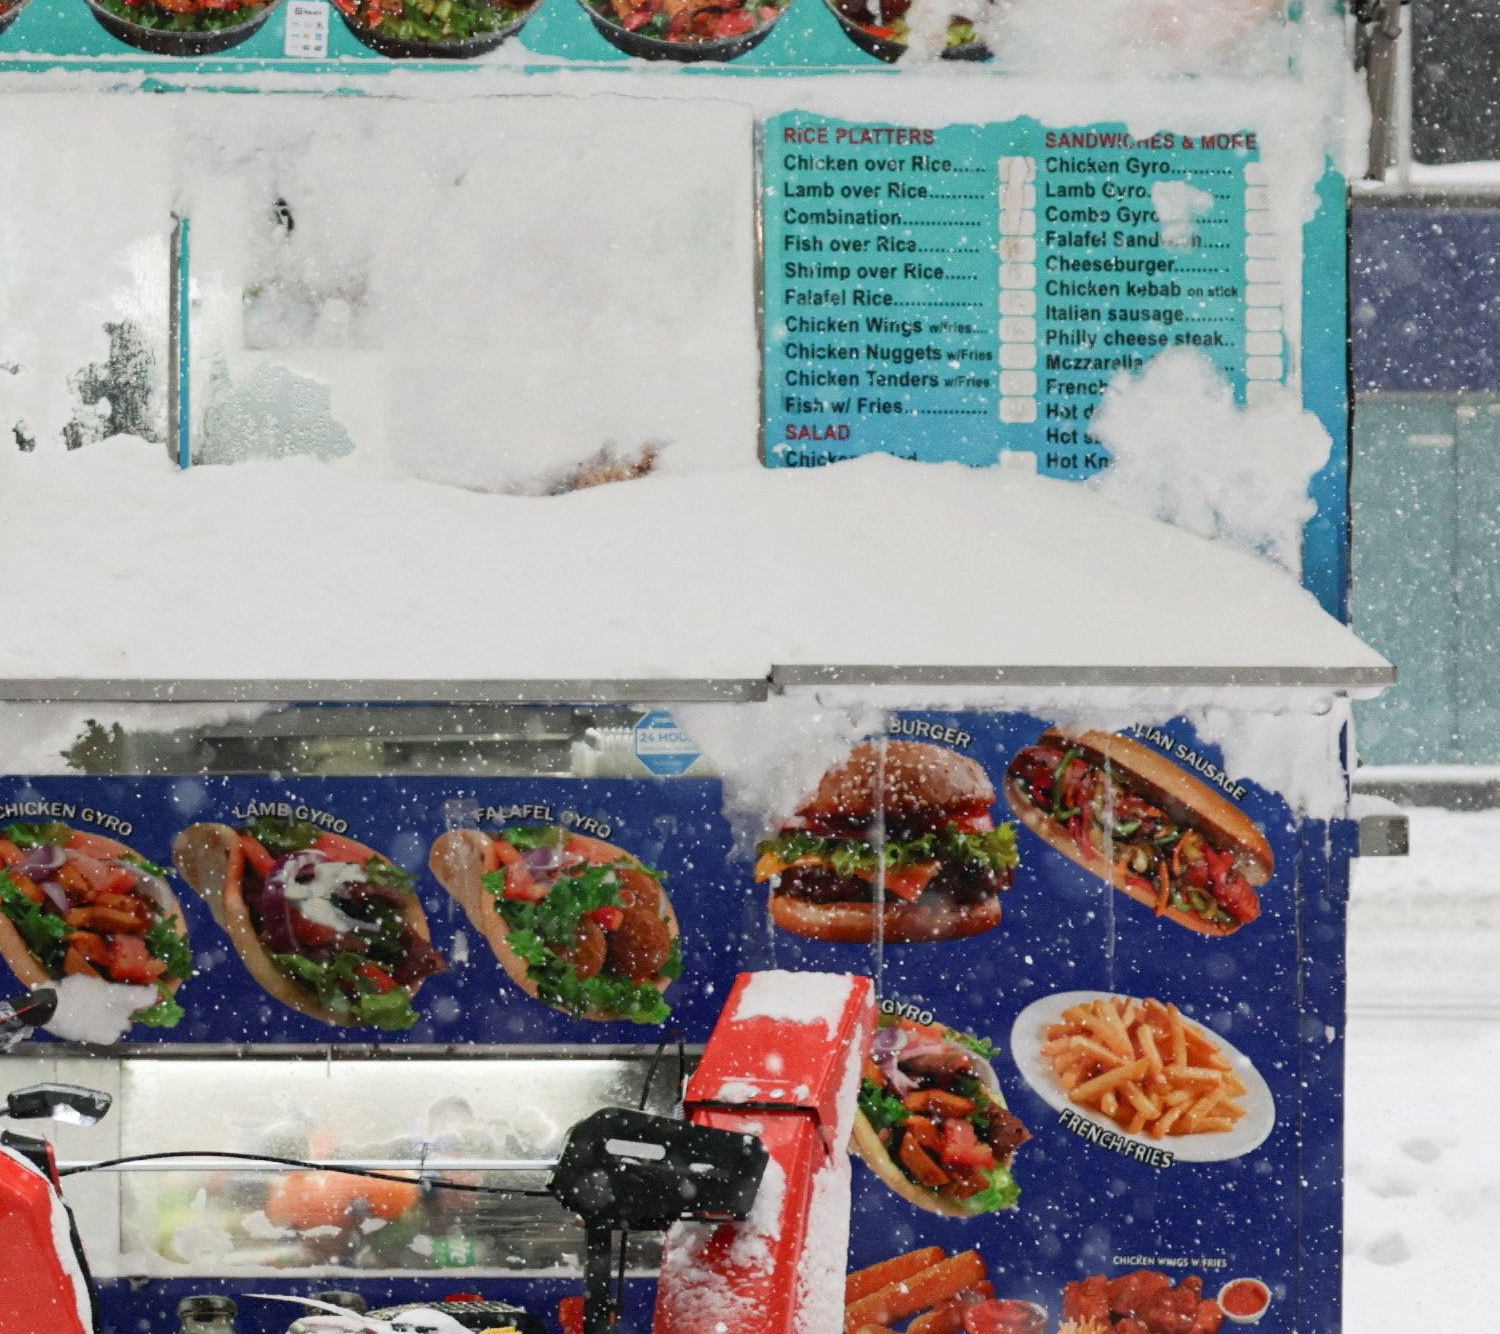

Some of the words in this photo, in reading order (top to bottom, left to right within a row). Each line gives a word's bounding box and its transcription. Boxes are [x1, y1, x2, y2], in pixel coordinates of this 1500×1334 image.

[783, 127, 830, 145] RICE
[836, 127, 936, 146] PLATTERS
[783, 154, 859, 172] Chicken
[864, 158, 906, 172] over
[911, 155, 953, 173] Rice
[1044, 156, 1120, 174] Chicken
[1125, 157, 1171, 178] Gyro
[783, 181, 835, 199] Lamb
[840, 185, 882, 199] over
[887, 181, 928, 199] Rice
[1044, 181, 1096, 199] Lamb
[783, 207, 902, 225] Combination
[1044, 206, 1112, 223] Combo
[783, 234, 824, 252] Fish
[829, 239, 871, 253] over
[876, 235, 917, 253] Rice
[1044, 231, 1108, 249] Falafel
[1112, 231, 1203, 249] Sandh
[784, 261, 851, 281] Shrimp
[856, 265, 898, 280] over
[903, 262, 944, 280] Rice
[1044, 255, 1176, 276] Cheeseburger
[784, 289, 846, 307] Falafel
[853, 289, 894, 307] Rice
[1044, 280, 1120, 298] Chicken
[1125, 280, 1182, 298] kebab
[1186, 286, 1204, 298] on
[1207, 284, 1239, 298] stick
[1044, 306, 1102, 322] Italian
[1107, 309, 1185, 326] sausage
[785, 315, 860, 334] Chicken
[865, 316, 923, 338] Wings
[1044, 329, 1098, 349] Philly
[1103, 329, 1169, 347] cheese
[1174, 330, 1223, 348] steak
[785, 342, 860, 360] Chicken
[865, 343, 943, 365] Nuggets
[785, 369, 860, 387] Chicken
[865, 369, 940, 388] Tenders
[784, 396, 825, 414] Fish
[857, 396, 904, 414] Fries
[1044, 403, 1078, 420] Hot
[785, 423, 851, 441] SALAD
[785, 450, 860, 468] Chicke
[1044, 452, 1078, 469] Hot
[658, 732, 690, 743] HOU
[1173, 742, 1249, 803] SAUSAGE
[81, 806, 134, 838] GYRO
[234, 801, 289, 820] LAMB
[293, 803, 349, 835] GYRO
[474, 804, 555, 823] FALAFEL
[560, 809, 612, 840] GYRO
[880, 998, 934, 1027] GYRO
[1058, 1107, 1127, 1153] FRENCH
[1124, 1139, 1176, 1169] FRIES
[1112, 1254, 1156, 1266] CHICKEN
[1157, 1256, 1189, 1268] WINGS
